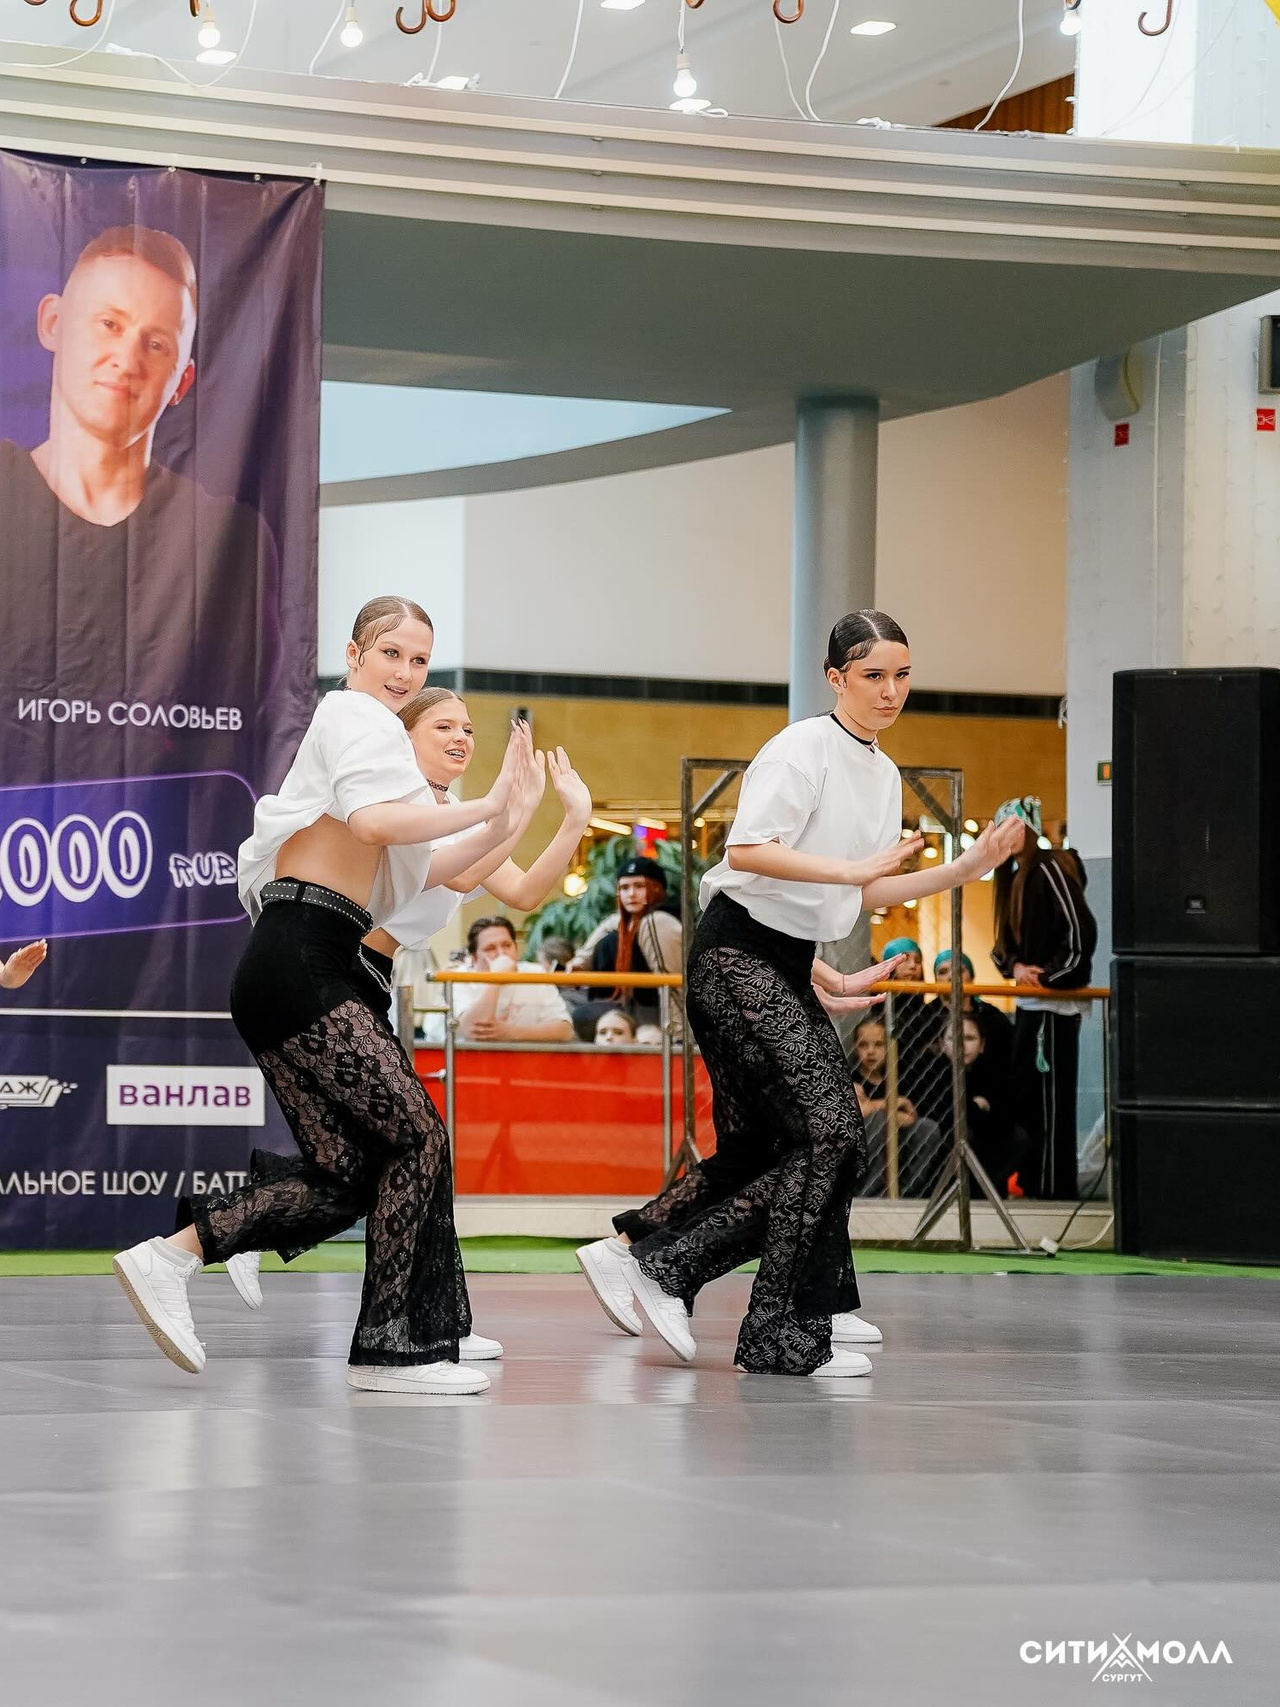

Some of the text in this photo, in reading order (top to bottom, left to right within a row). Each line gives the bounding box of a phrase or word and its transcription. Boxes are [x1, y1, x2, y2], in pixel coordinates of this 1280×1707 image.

[19, 698, 243, 731] ИГОРЬ СОЛОВЬЕВ
[119, 1082, 252, 1107] ванлав
[102, 1170, 168, 1196] ШОУ
